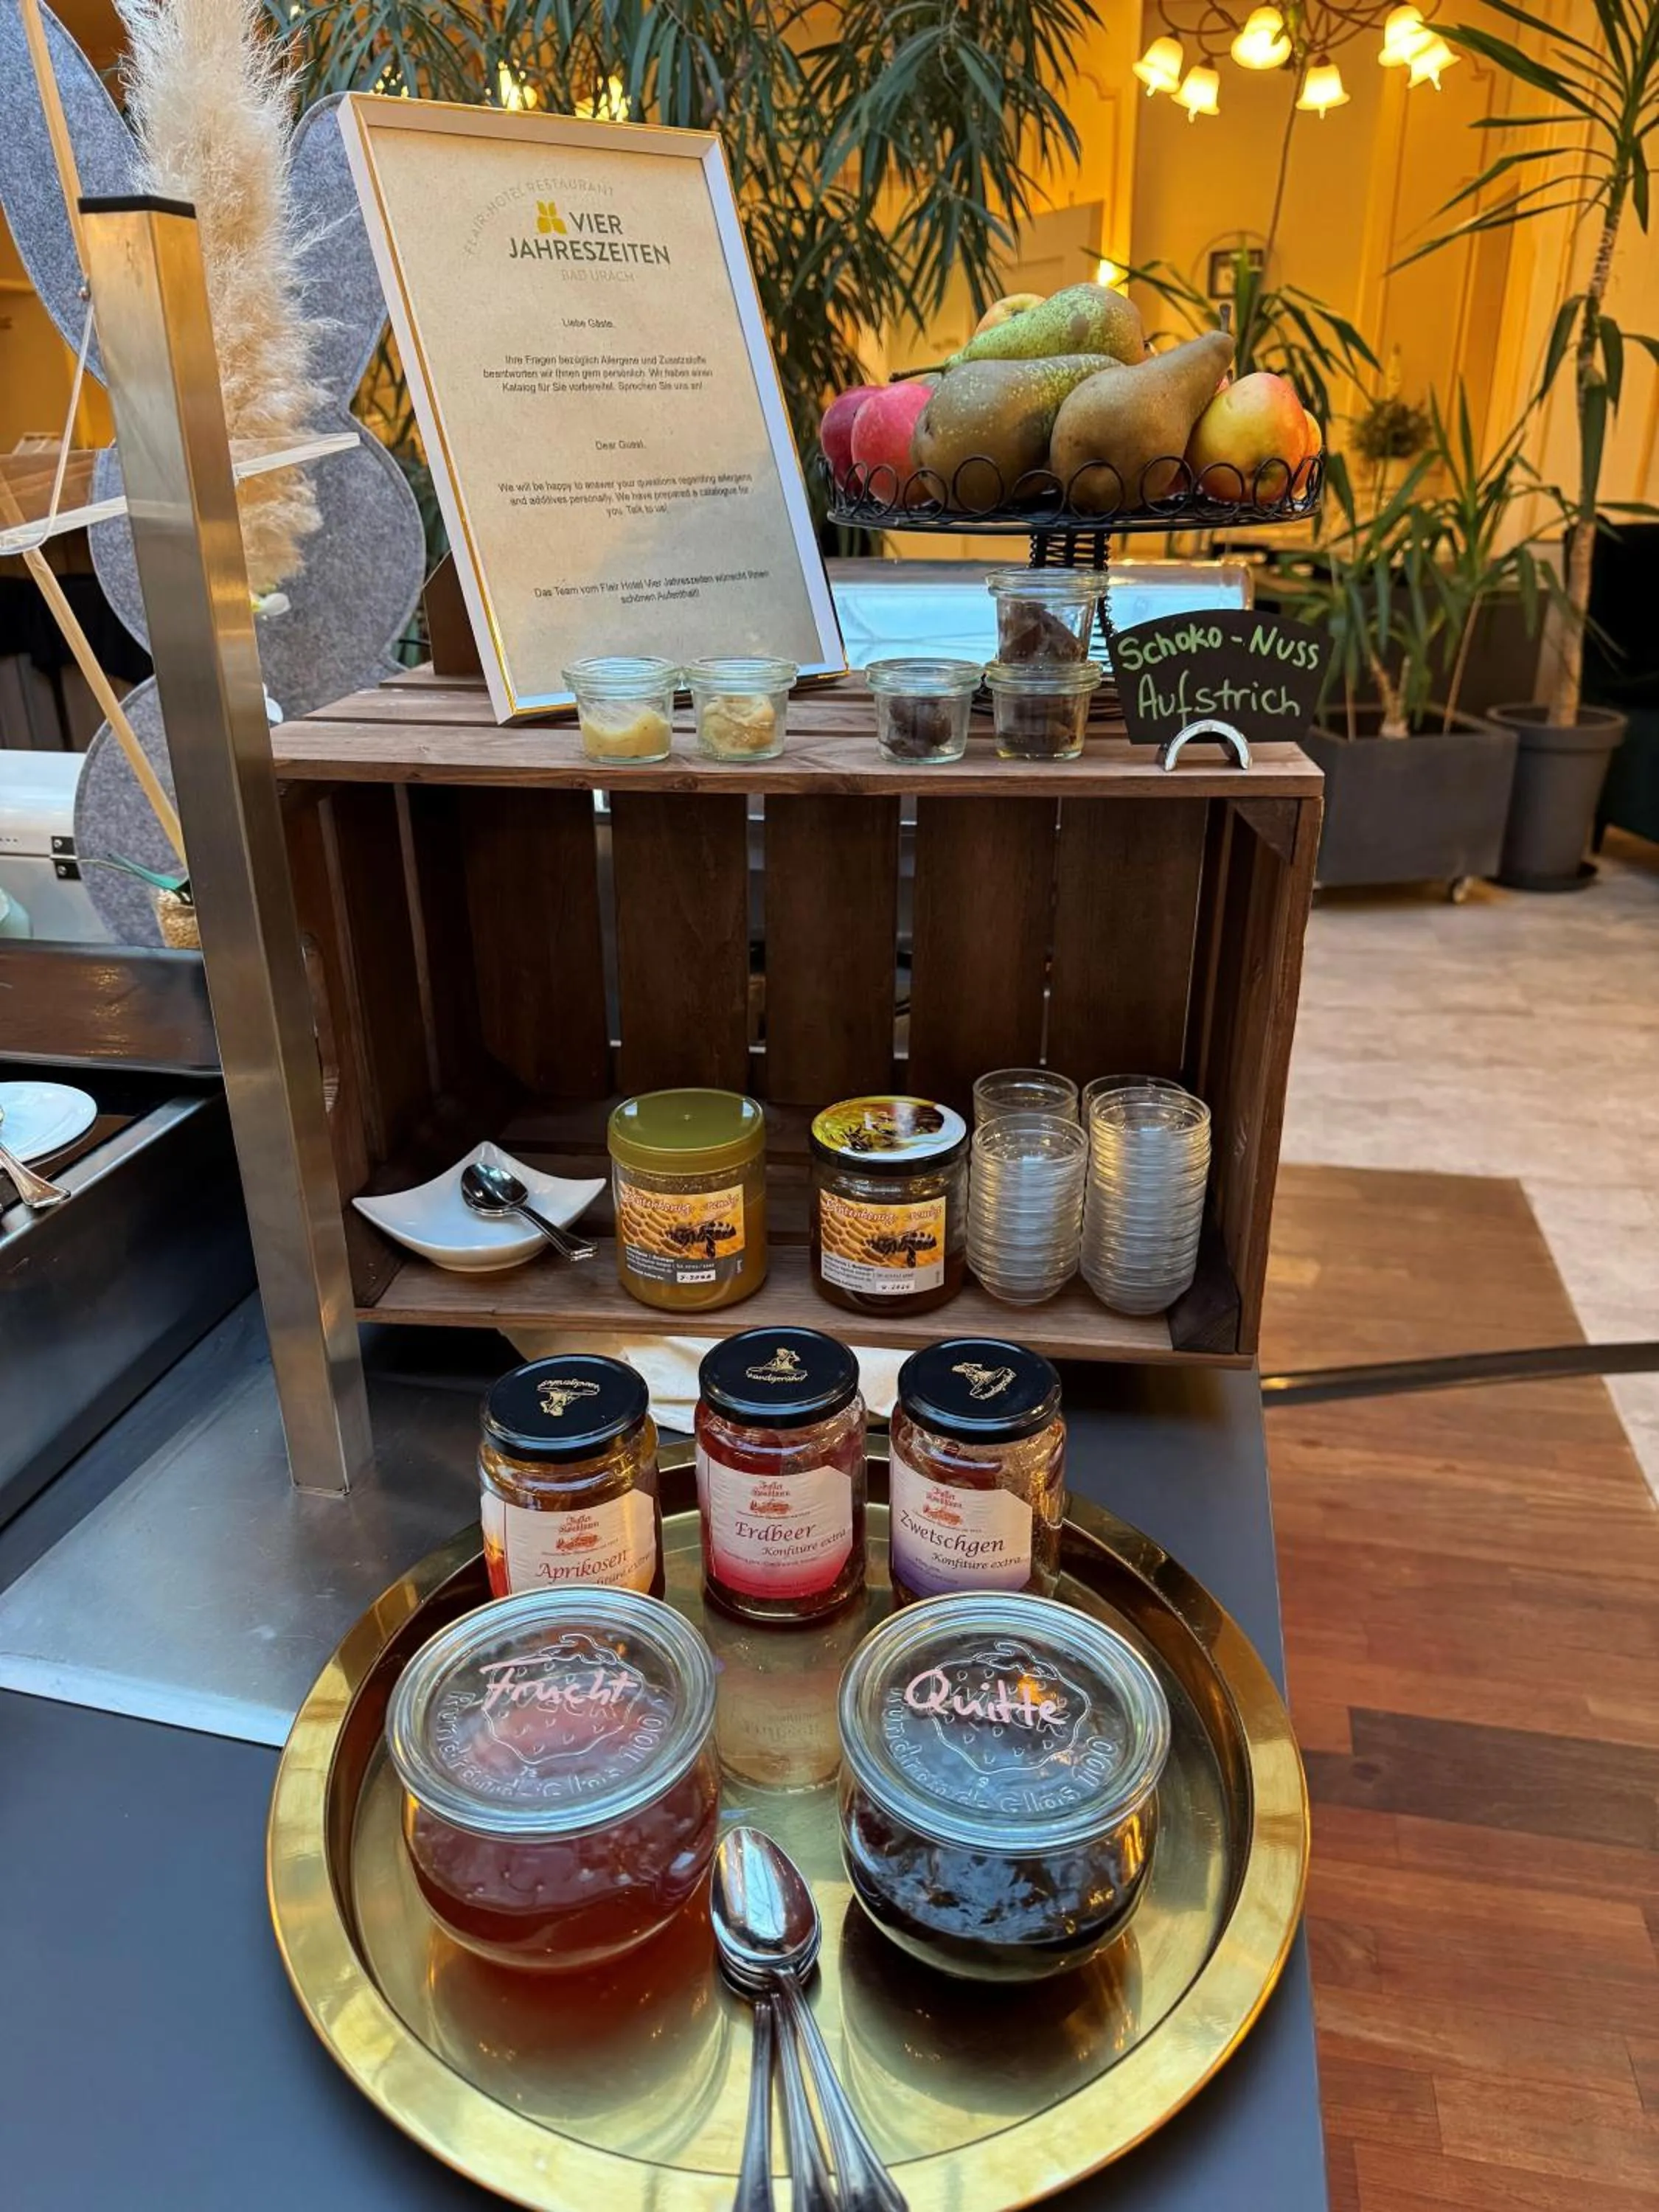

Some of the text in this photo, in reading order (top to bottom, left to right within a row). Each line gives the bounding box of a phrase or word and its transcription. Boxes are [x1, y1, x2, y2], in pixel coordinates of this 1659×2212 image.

[526, 177, 614, 198] RESTAURANT
[568, 212, 623, 234] VIER
[509, 237, 671, 264] JAHRESZEITEN
[561, 269, 635, 282] BAD URACH
[595, 441, 616, 451] Dear
[534, 588, 552, 598] Das
[554, 585, 579, 596] Team
[1116, 623, 1222, 671] Schoko
[1248, 625, 1320, 670] Nuss
[1138, 669, 1301, 730] Aufstrich
[735, 1520, 816, 1543] Erdbeer
[762, 1528, 846, 1558] Konfitüre extra
[899, 1510, 1005, 1558] Zwetschgen
[536, 1549, 627, 1585] Aprikosen
[931, 1552, 990, 1570] Konfitüre
[990, 1555, 1022, 1569] extra
[479, 1655, 639, 1711] Frucht
[905, 1668, 1067, 1727] Quitte
[1071, 1734, 1119, 1789] 100
